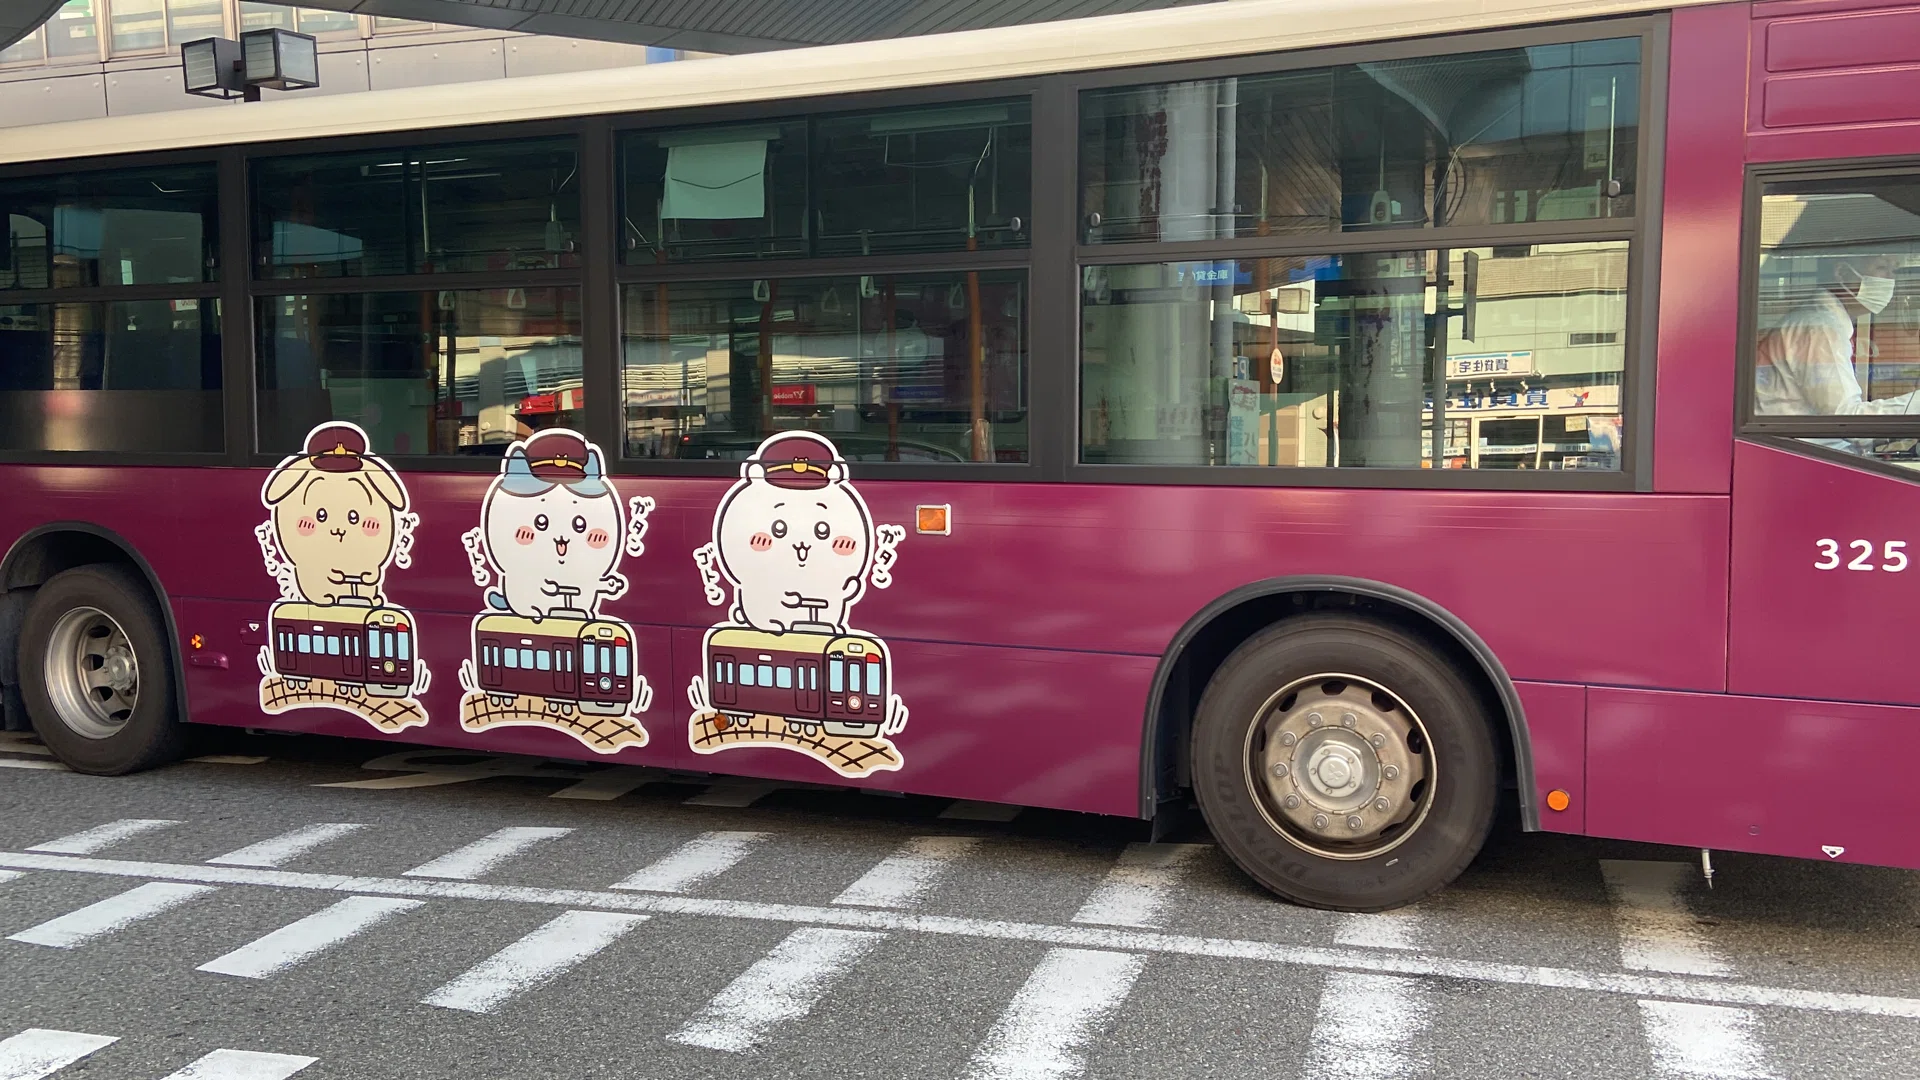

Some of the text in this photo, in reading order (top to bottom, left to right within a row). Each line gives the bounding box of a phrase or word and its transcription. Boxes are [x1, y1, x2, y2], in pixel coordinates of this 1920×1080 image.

[258, 525, 277, 571] ゴトン
[399, 514, 416, 563] ガタン
[630, 501, 651, 552] ガタン
[465, 532, 486, 581] ゴトン
[697, 547, 720, 600] ゴトン
[876, 529, 901, 583] ガタン
[1814, 538, 1908, 572] 325
